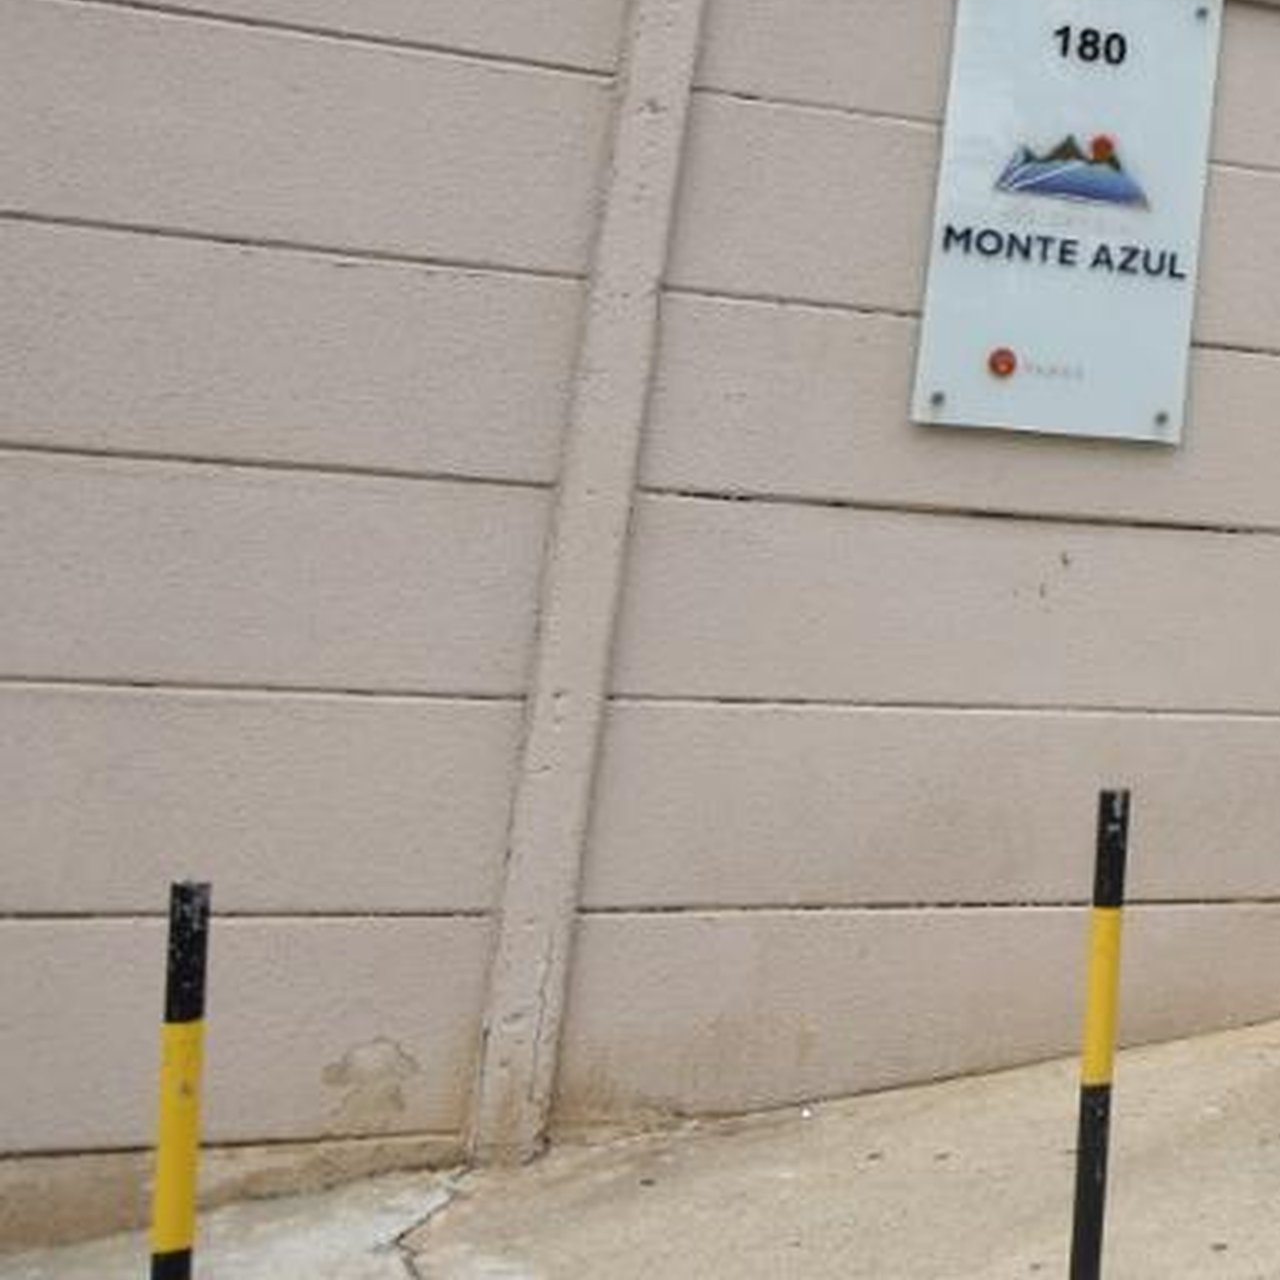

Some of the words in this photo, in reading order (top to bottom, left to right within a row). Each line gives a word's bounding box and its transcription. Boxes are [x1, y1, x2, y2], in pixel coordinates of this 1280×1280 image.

[1053, 25, 1127, 66] 180
[942, 224, 1080, 266] MONTE
[1090, 243, 1187, 280] AZUL
